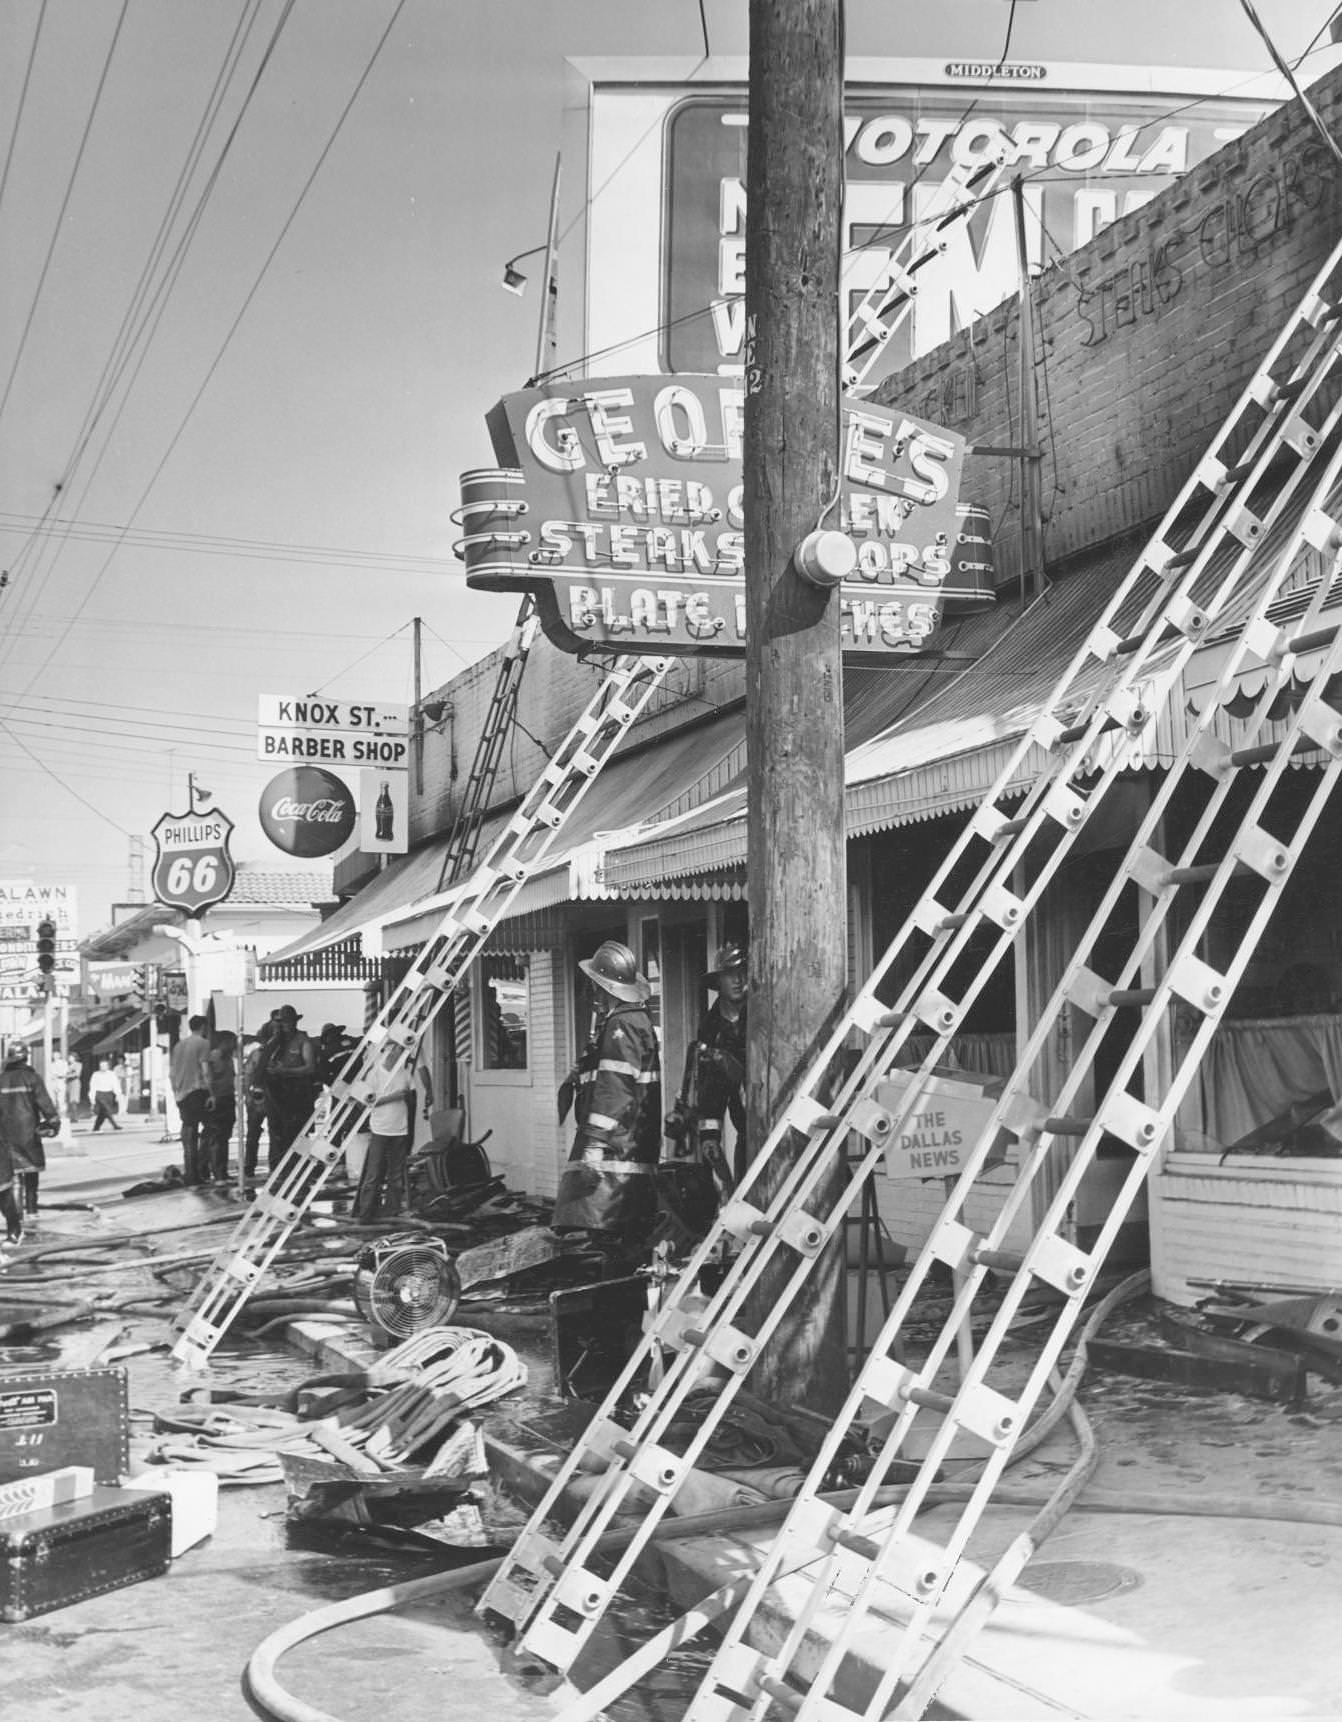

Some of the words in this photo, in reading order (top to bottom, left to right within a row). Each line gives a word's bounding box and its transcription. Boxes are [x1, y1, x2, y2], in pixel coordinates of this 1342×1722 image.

[950, 64, 1042, 79] MIDDLETON
[844, 114, 1188, 173] OTOROLA
[525, 385, 955, 502] GEOE'S
[541, 520, 745, 571] STEAKS
[858, 541, 951, 580] OPS
[569, 585, 710, 630] PLATE
[279, 701, 340, 725] KNOX
[264, 736, 346, 759] BARBER
[353, 740, 406, 763] SHOP
[164, 823, 222, 845] PHILLIPS
[167, 855, 219, 895] 66
[911, 1111, 946, 1129] THE
[900, 1130, 963, 1150] DALLAS
[909, 1150, 961, 1169] NEWS
